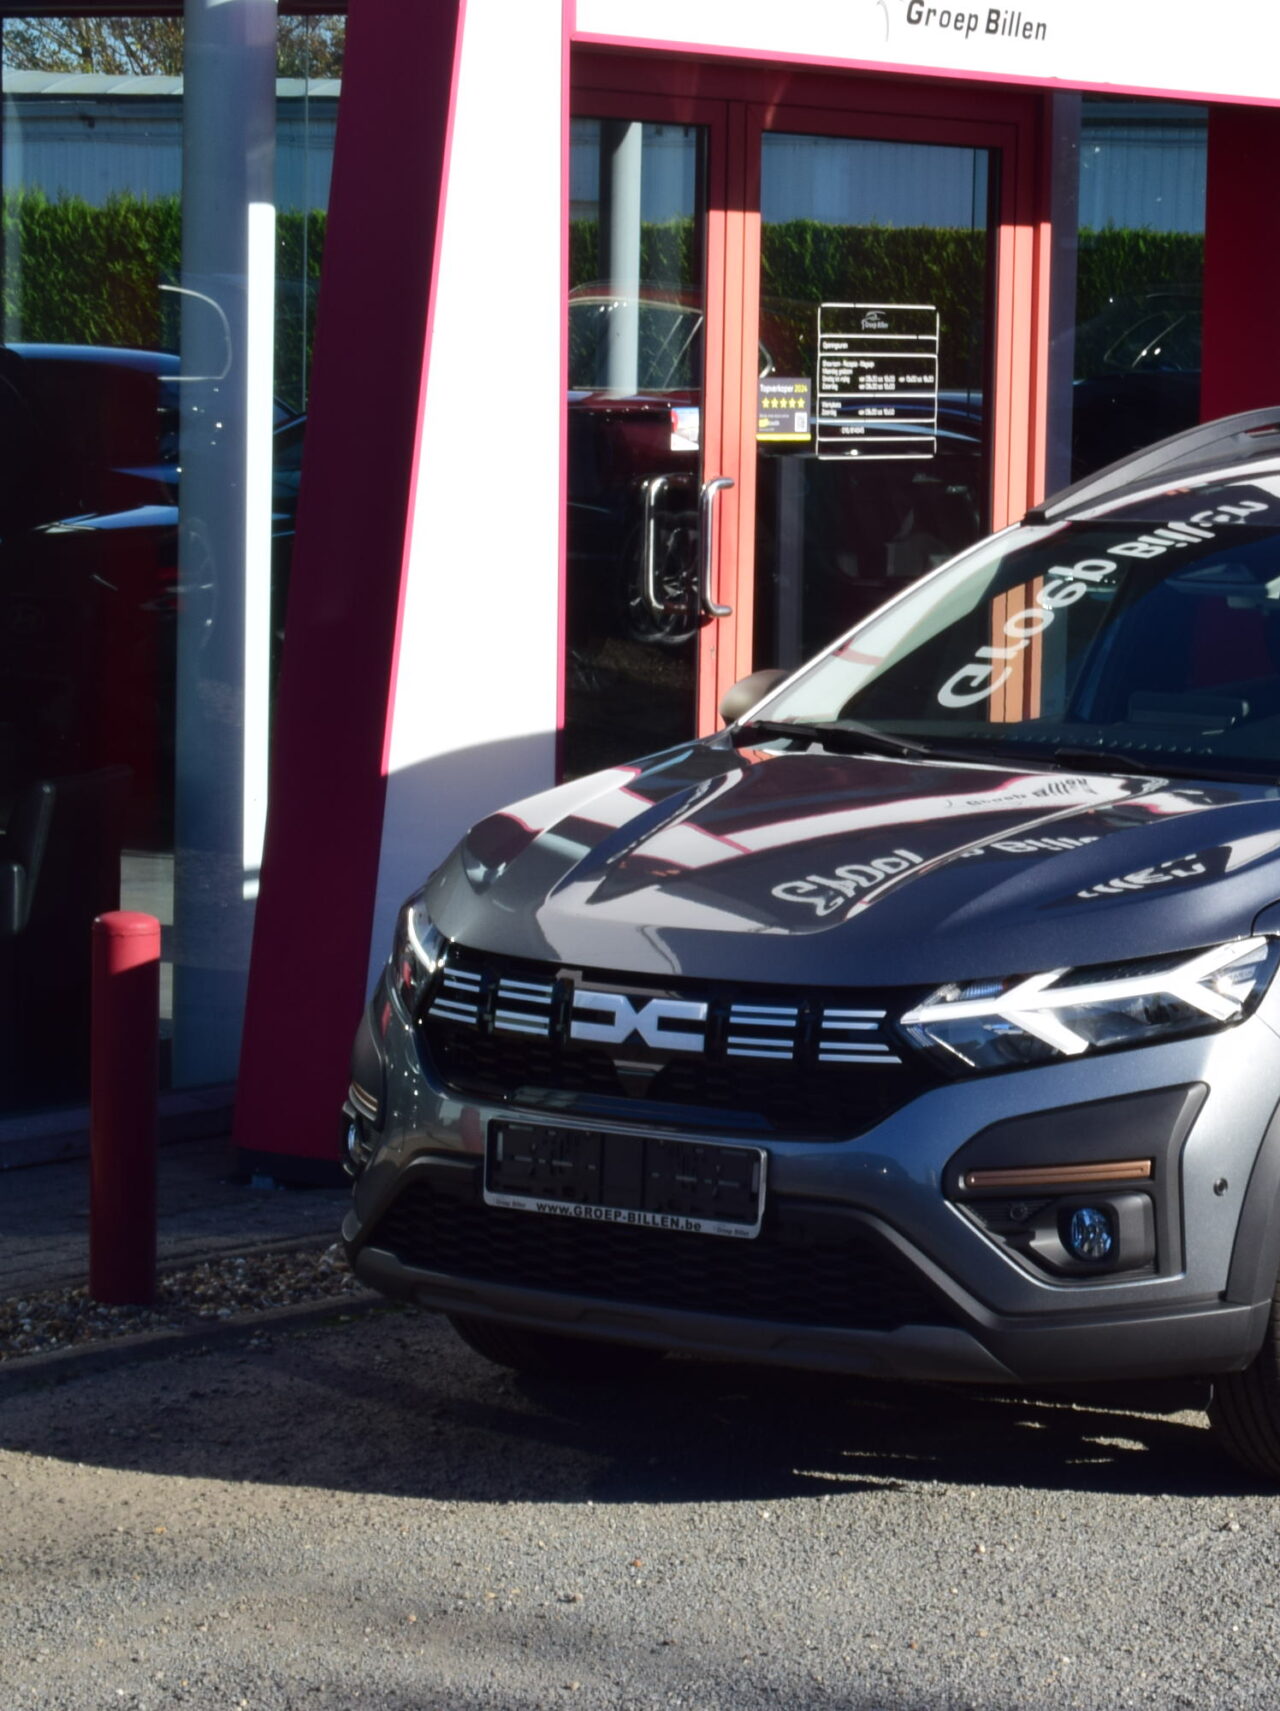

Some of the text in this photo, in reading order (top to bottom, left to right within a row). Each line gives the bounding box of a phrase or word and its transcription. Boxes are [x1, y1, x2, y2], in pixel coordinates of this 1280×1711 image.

[906, 0, 1047, 41] Groep Billen
[536, 1201, 702, 1232] www.GROEP-BILLEN.be
